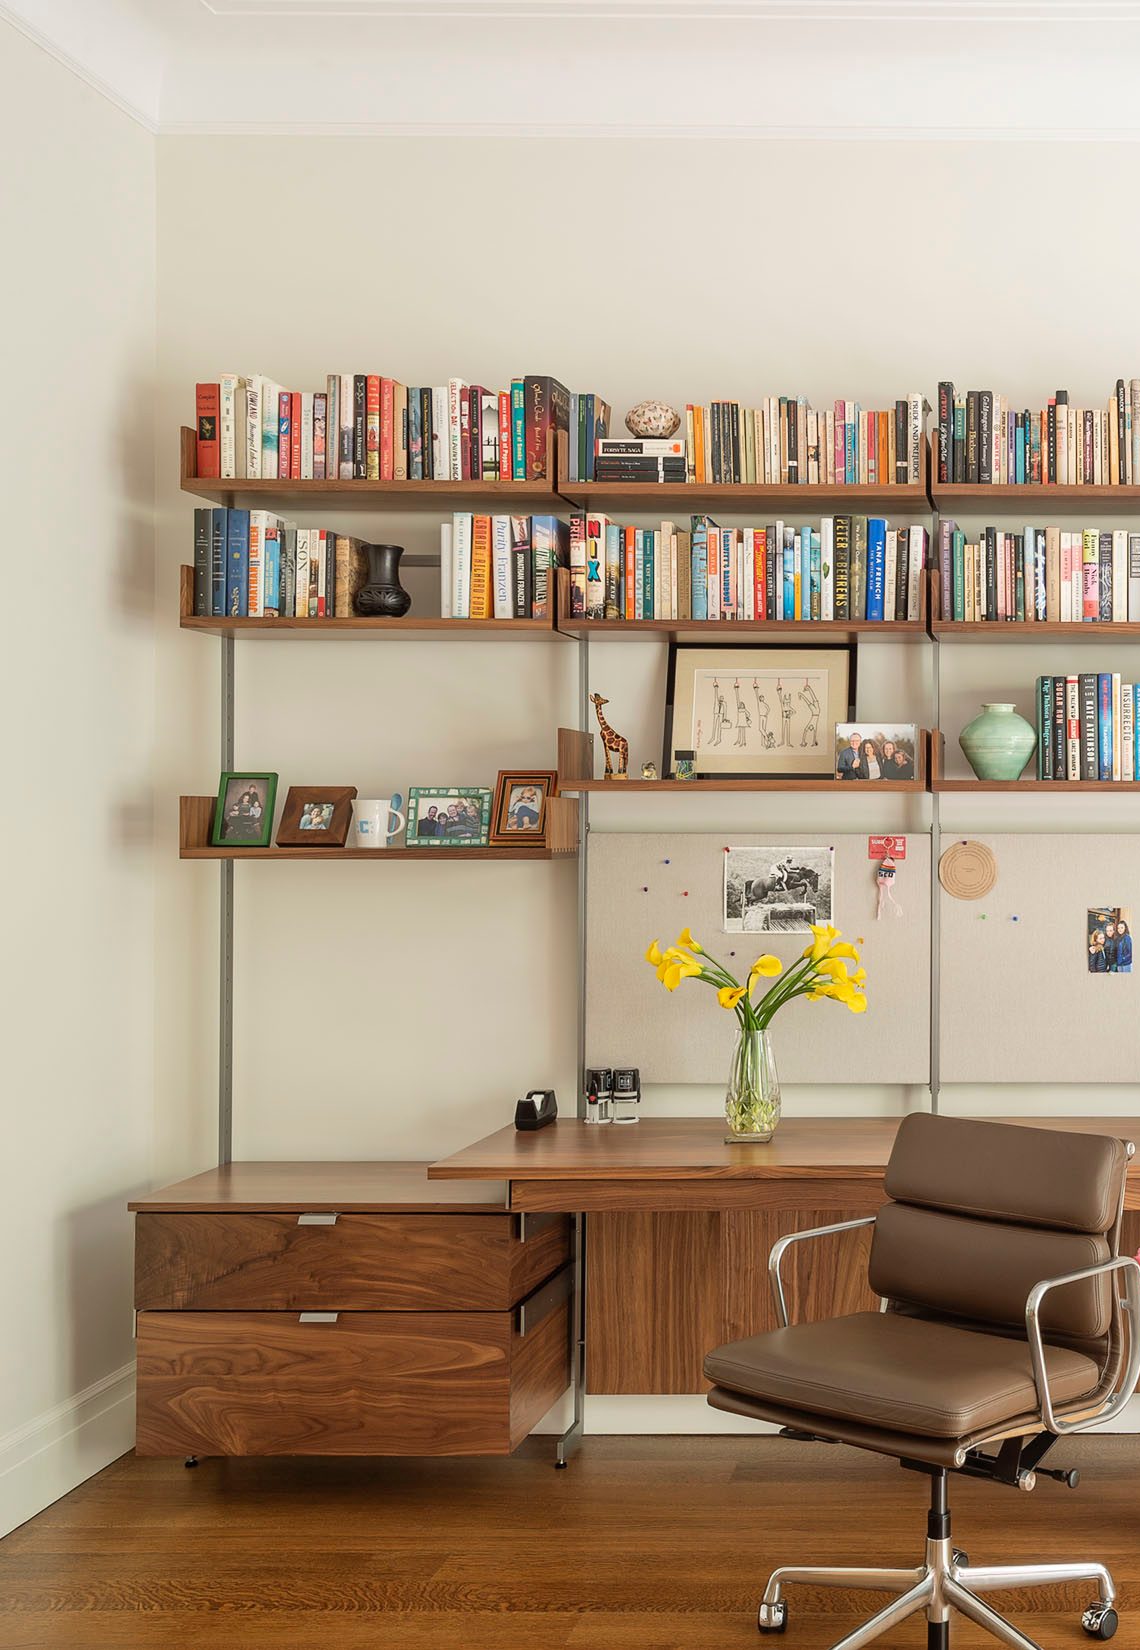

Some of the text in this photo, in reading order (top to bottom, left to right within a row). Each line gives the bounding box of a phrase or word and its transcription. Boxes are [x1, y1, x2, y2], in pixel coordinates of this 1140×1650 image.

[248, 391, 258, 420] LOWLAND
[298, 540, 308, 570] SON
[495, 520, 507, 601] Purity Franzen
[836, 519, 847, 606] PETER BEHRENS
[1089, 534, 1097, 557] Funny
[250, 527, 258, 612] JONATHAN LETHEM
[472, 520, 487, 615] CANADA RICHARD FORD
[536, 572, 547, 605] FRANZEN
[1082, 569, 1090, 596] Hornby
[517, 581, 525, 605] FRANZEN
[1086, 700, 1094, 762] KATE ATKINSON
[1123, 689, 1131, 741] INSURRECTO
